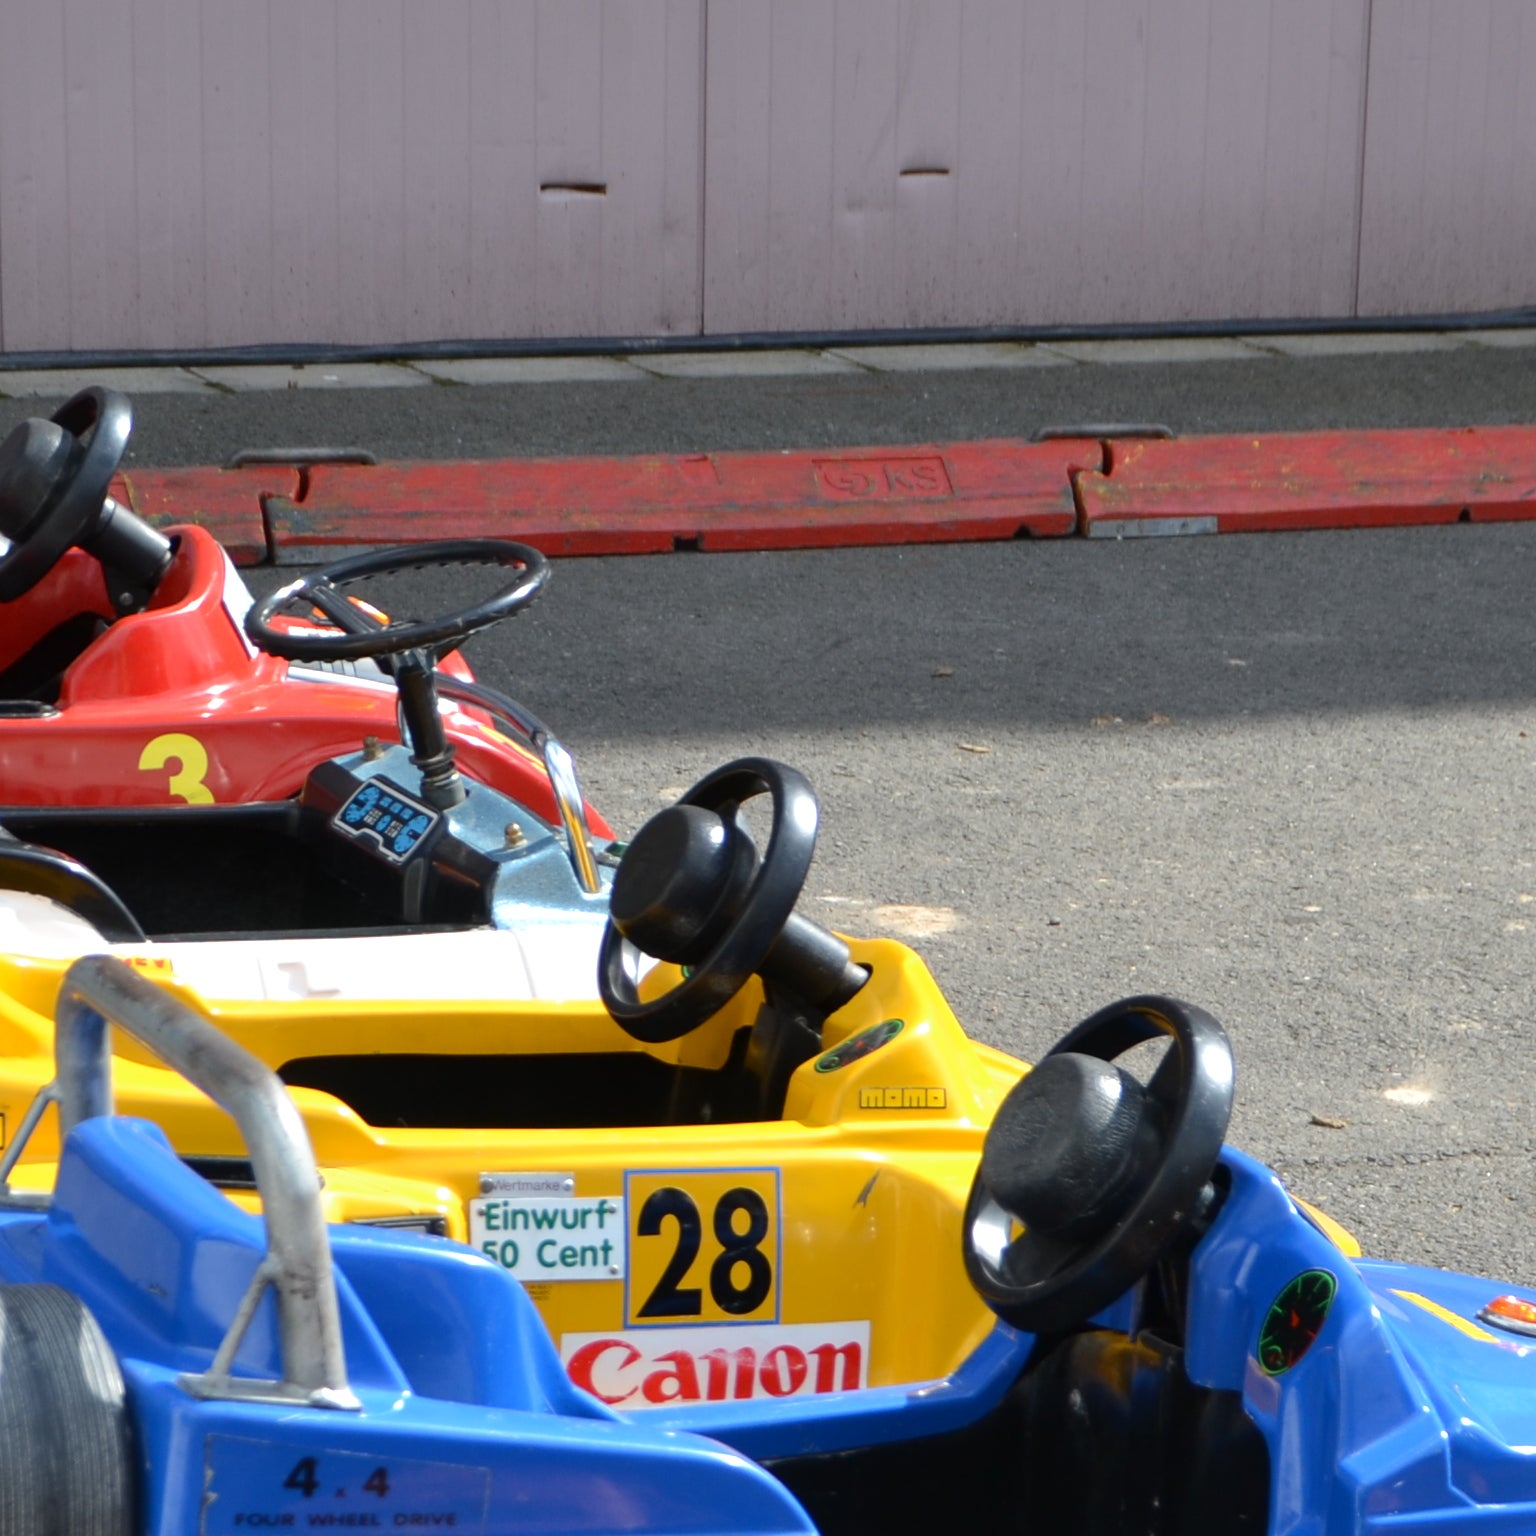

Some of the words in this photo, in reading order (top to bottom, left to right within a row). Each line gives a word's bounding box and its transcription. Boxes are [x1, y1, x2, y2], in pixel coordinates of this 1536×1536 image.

[138, 732, 215, 805] 3
[491, 1179, 561, 1193] Wertmarke
[484, 1199, 609, 1230] Einwurf
[482, 1240, 519, 1269] 50
[537, 1238, 614, 1268] Cent
[636, 1186, 774, 1318] 28
[567, 1338, 862, 1405] Canon
[234, 1512, 295, 1527] FOUR
[307, 1512, 381, 1527] WHEEL
[393, 1511, 458, 1527] DRIVE
